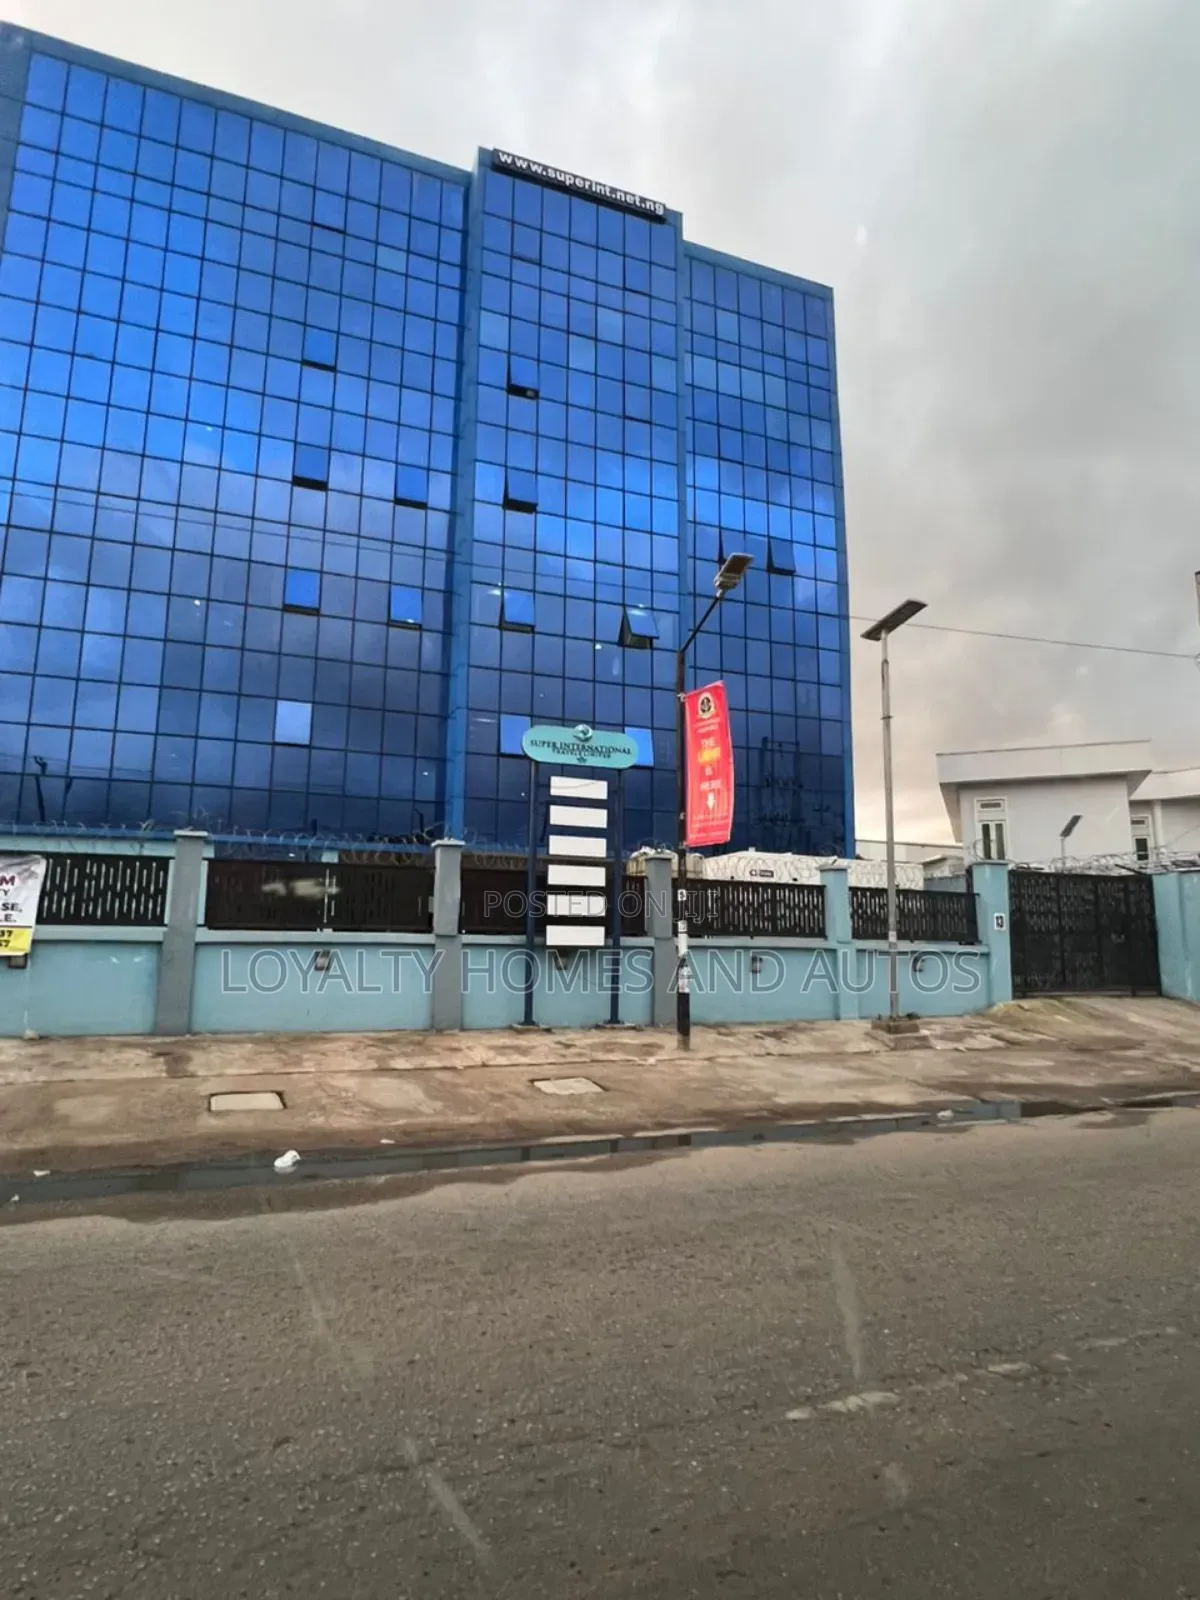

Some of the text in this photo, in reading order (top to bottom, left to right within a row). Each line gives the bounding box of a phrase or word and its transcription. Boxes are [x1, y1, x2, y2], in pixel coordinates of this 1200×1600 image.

[498, 151, 665, 215] www.superint.net.ng
[530, 739, 632, 756] SUPER INTERNATIONAL
